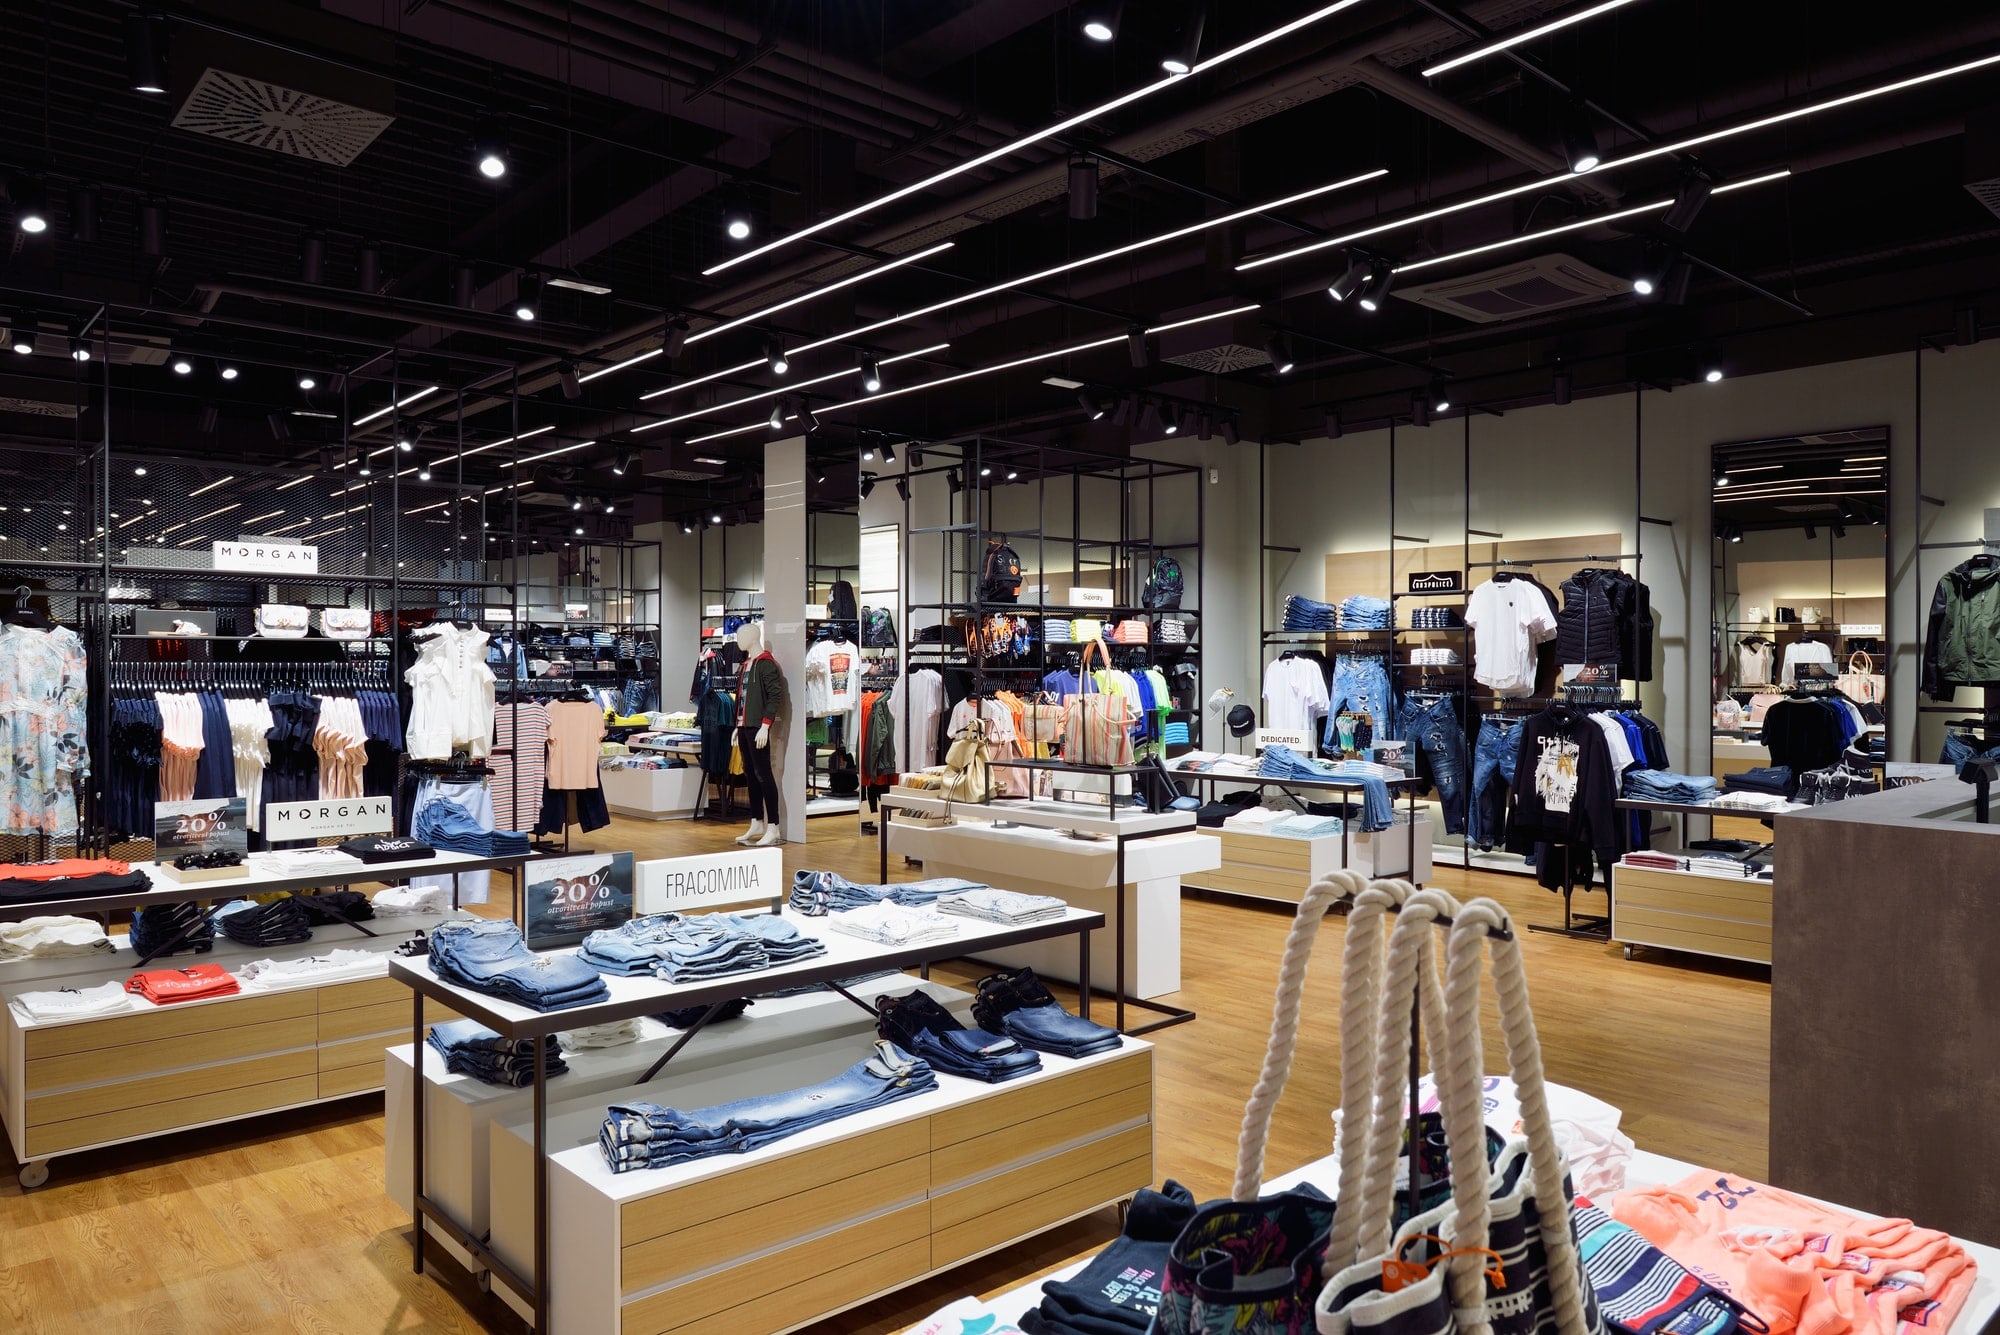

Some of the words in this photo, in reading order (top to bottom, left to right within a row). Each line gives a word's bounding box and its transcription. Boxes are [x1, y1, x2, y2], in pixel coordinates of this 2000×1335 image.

[221, 547, 312, 560] MORGAN
[1584, 664, 1609, 675] 20%
[1261, 735, 1302, 744] DEDICATED.
[1382, 748, 1405, 760] 20%
[278, 803, 386, 821] MORGAN
[175, 810, 227, 834] 20%
[550, 870, 610, 905] 20%
[666, 864, 760, 899] FRACOMINA
[589, 899, 614, 911] popust
